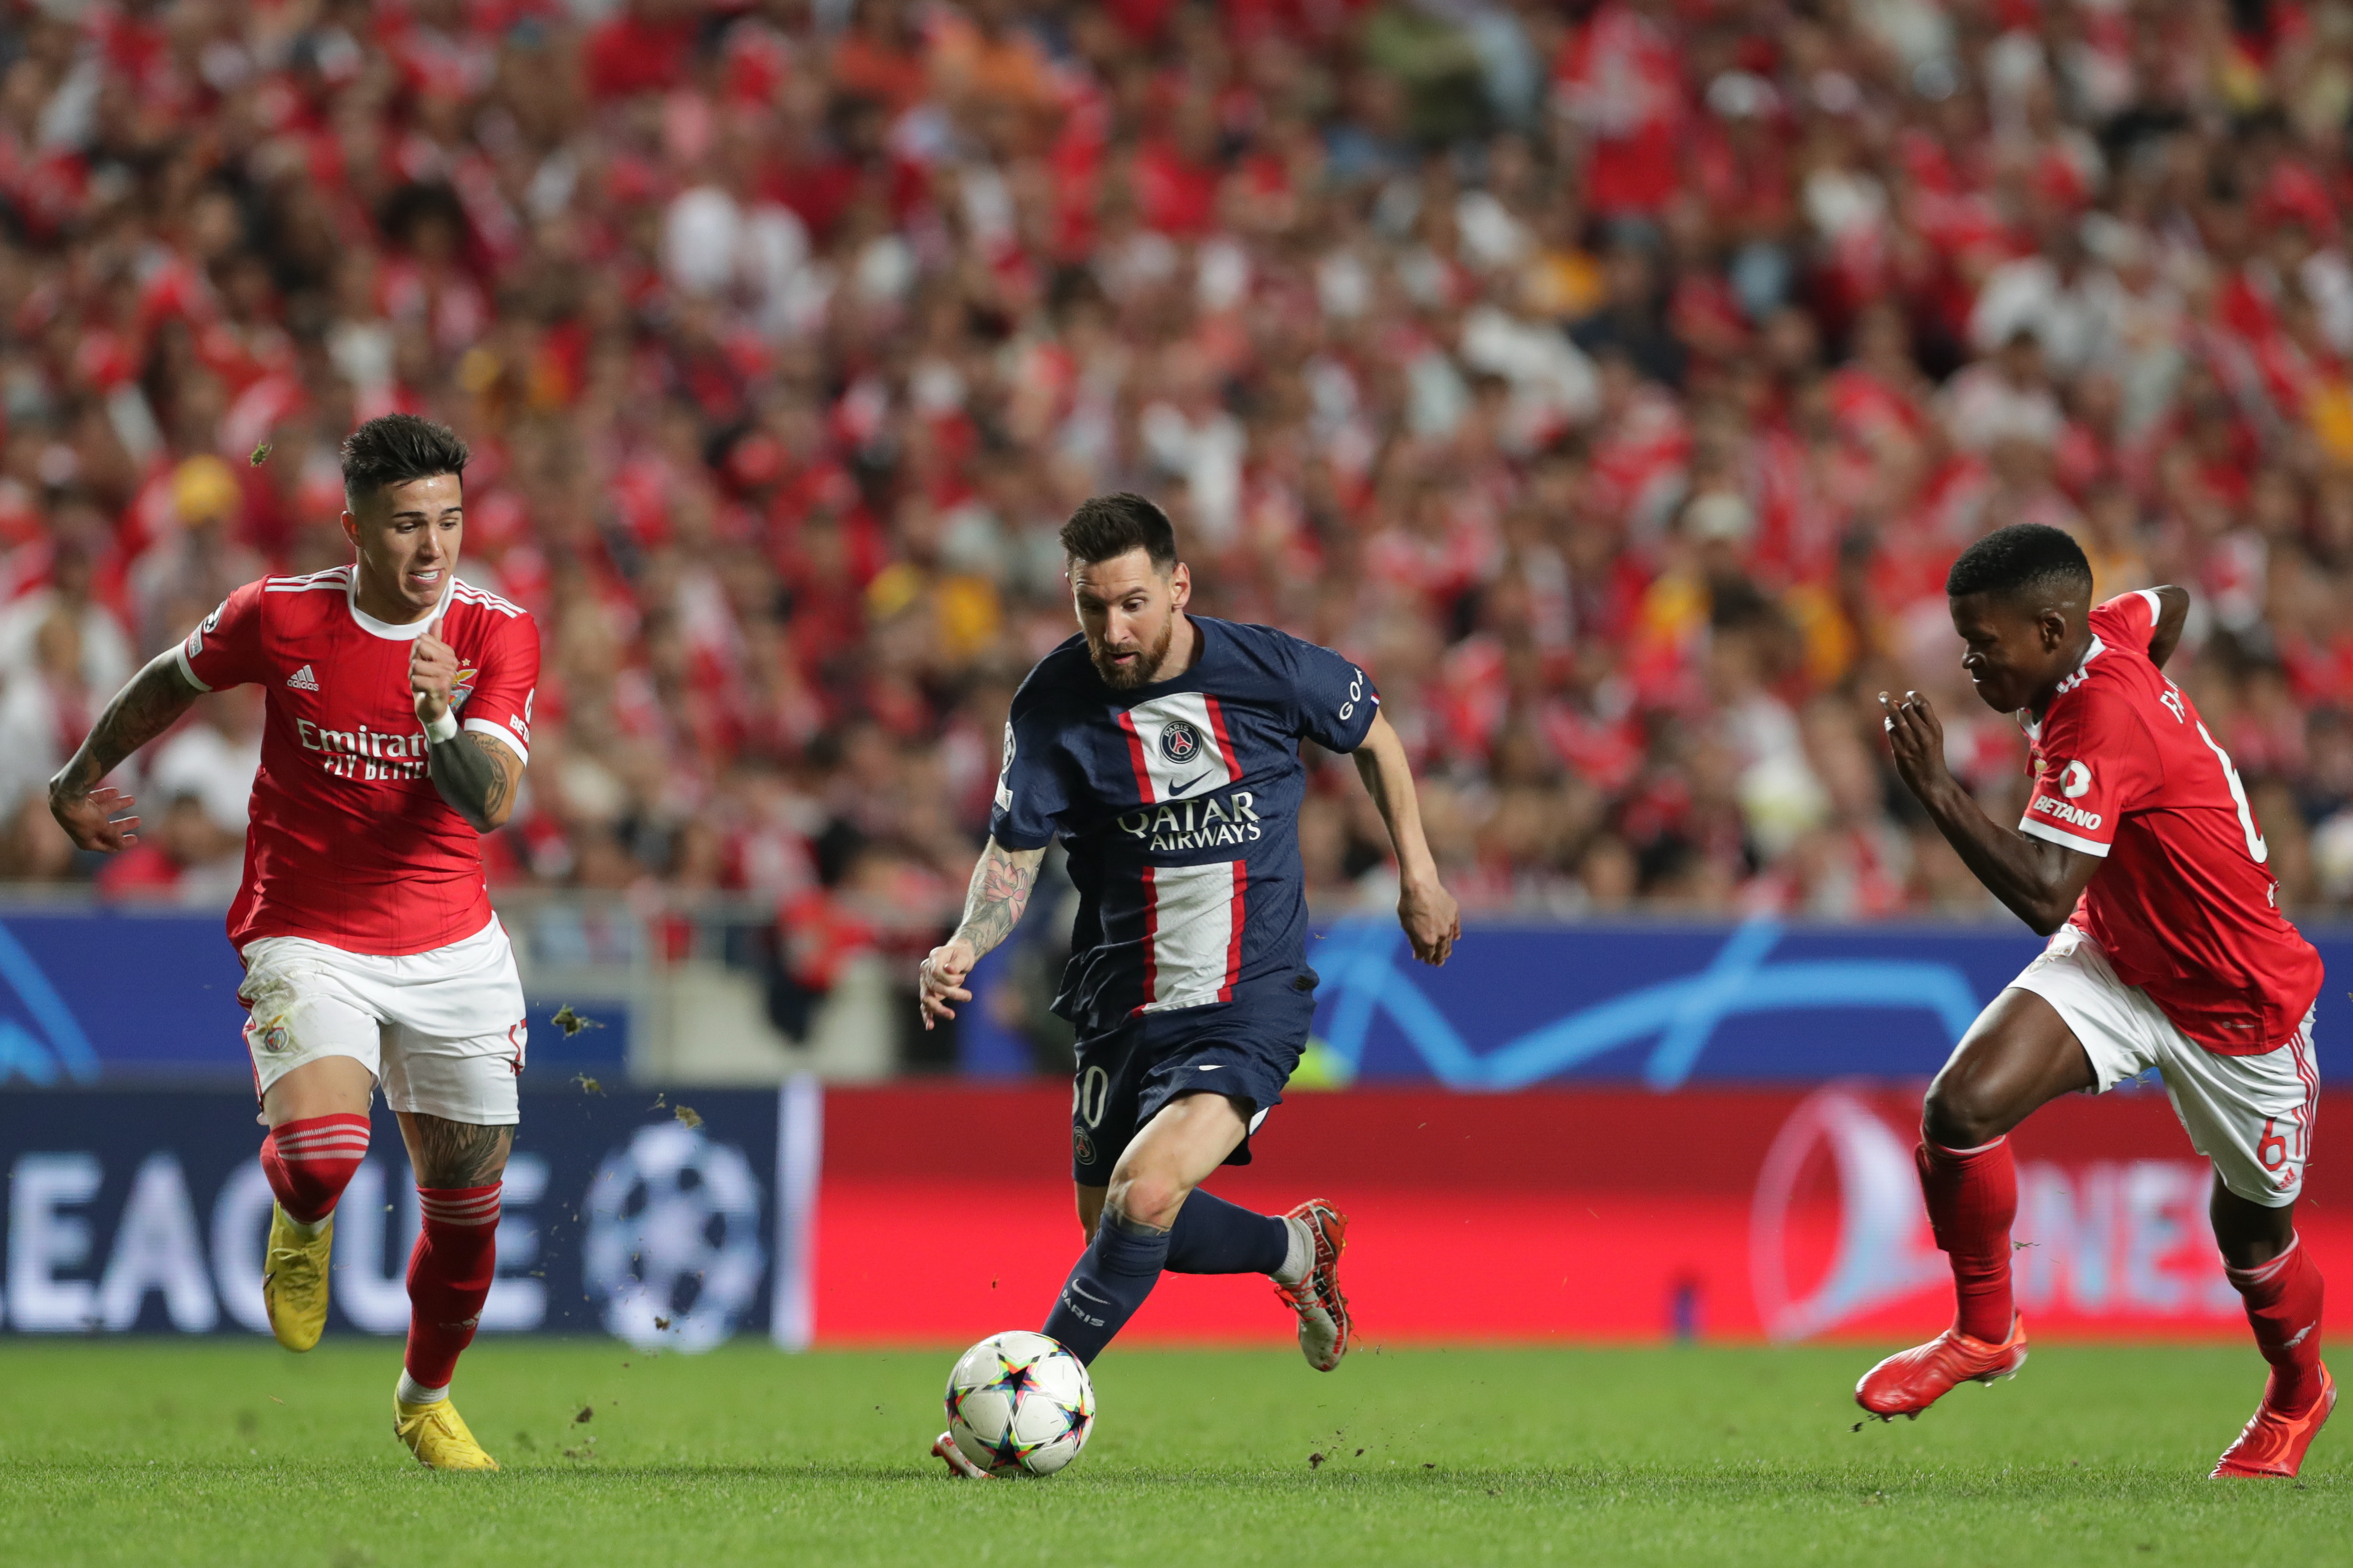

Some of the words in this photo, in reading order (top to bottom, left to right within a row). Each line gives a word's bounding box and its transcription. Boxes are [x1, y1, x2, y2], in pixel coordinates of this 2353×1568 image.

[287, 679, 319, 692] adidas
[296, 717, 429, 758] Emirat
[1164, 724, 1189, 737] PARIS
[365, 757, 431, 780] BETTE
[1116, 791, 1261, 839] QATAR
[2033, 795, 2102, 830] BETANO
[1149, 822, 1262, 851] AIRWAYS
[1061, 1288, 1106, 1327] PARIS
